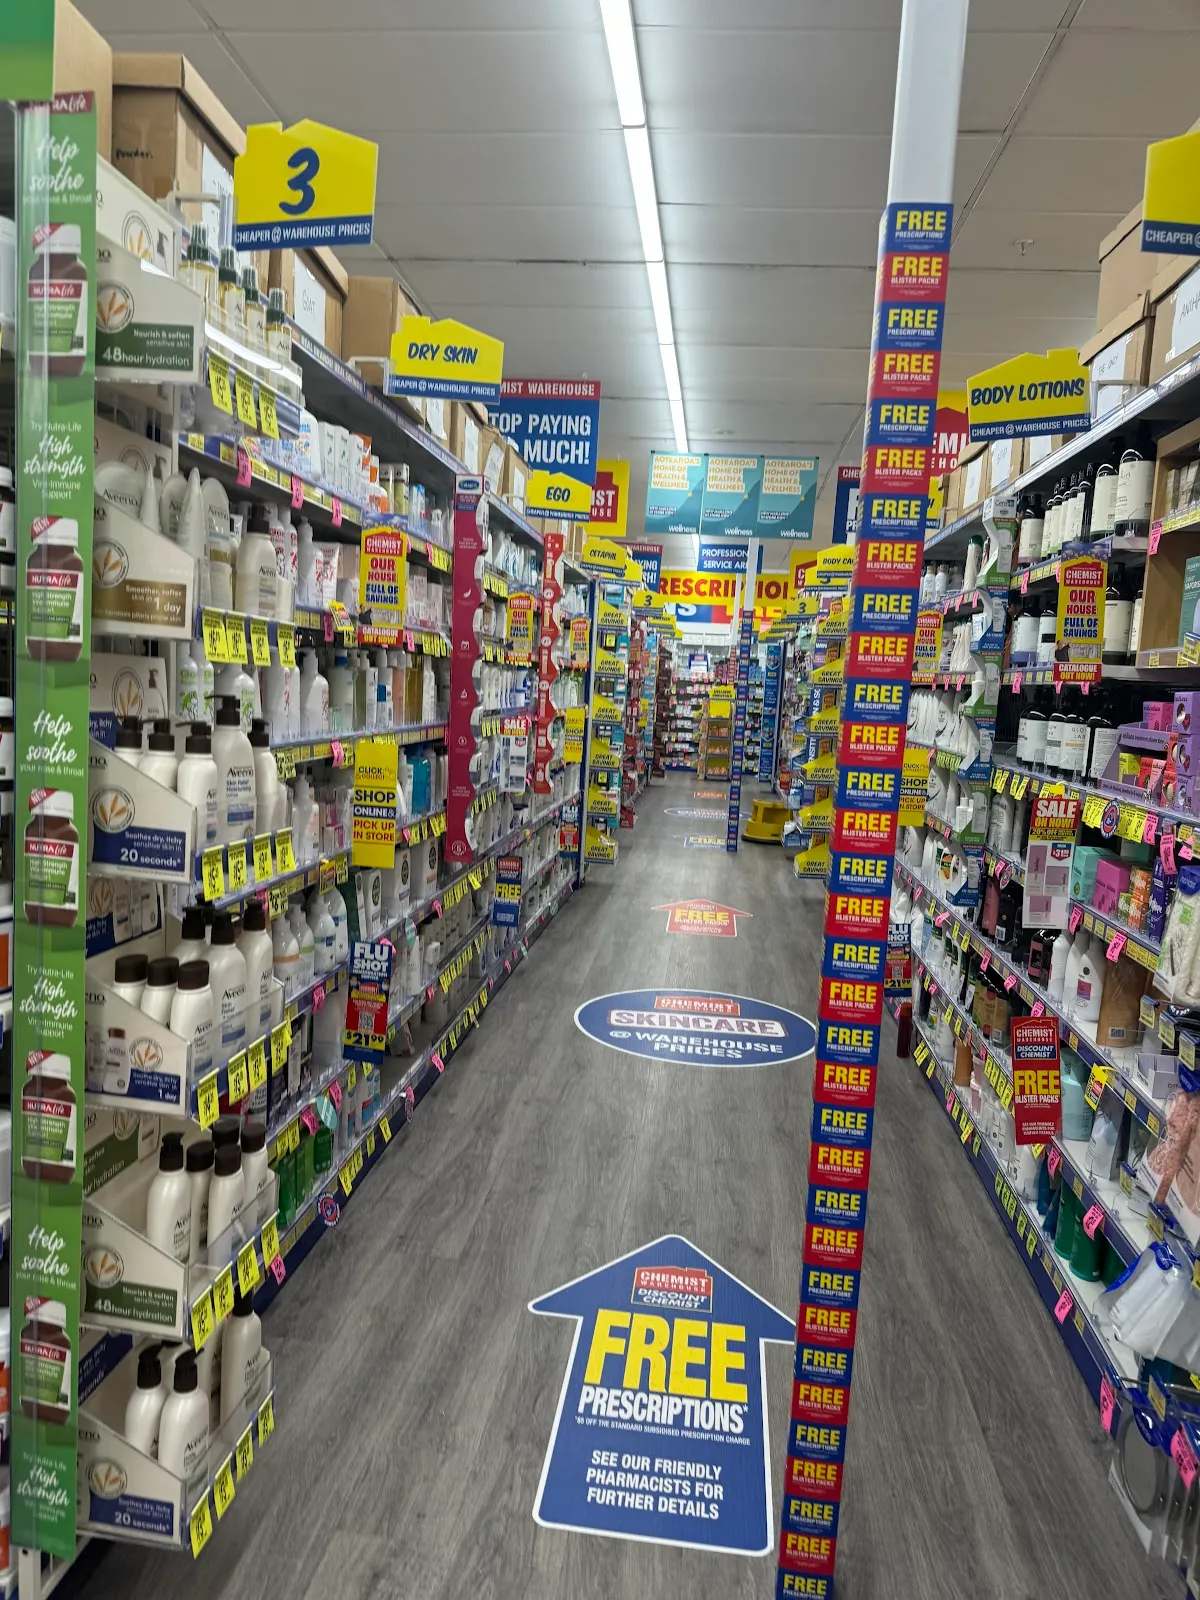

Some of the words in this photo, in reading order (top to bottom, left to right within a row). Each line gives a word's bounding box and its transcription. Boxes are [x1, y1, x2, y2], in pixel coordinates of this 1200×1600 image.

[36, 135, 80, 163] Help
[29, 163, 85, 193] soothe
[279, 147, 321, 216] 3
[896, 210, 947, 231] FREE
[235, 229, 271, 243] CHEAPER
[271, 226, 282, 243] @
[282, 225, 336, 240] WAREHOUSE
[338, 222, 370, 236] PRICES
[1145, 229, 1194, 245] CHEAPER
[891, 256, 943, 277] FREE
[888, 309, 938, 329] FREE
[168, 332, 190, 340] soften
[145, 353, 190, 367] hydration
[408, 342, 440, 360] DRY
[443, 345, 478, 364] SKIN
[884, 353, 934, 374] FREE
[428, 383, 469, 394] WAREHOUSE
[471, 385, 496, 396] PRICES
[528, 382, 595, 396] WAREHOUSE
[971, 385, 1014, 406] BODY
[1018, 377, 1085, 401] LOTIONS
[880, 405, 930, 424] FREE
[489, 412, 522, 433] TOP
[528, 413, 592, 437] PAYING
[972, 426, 1005, 437] CHEAPER
[1005, 424, 1015, 435] @
[1015, 420, 1061, 431] WAREHOUSE
[1062, 418, 1089, 428] PRICES
[38, 432, 74, 459] High
[524, 439, 591, 465] MUCH!
[23, 451, 86, 479] strength
[876, 448, 926, 469] FREE
[546, 486, 571, 502] EGO
[871, 499, 921, 519] FREE
[668, 525, 697, 534] wellness
[725, 528, 753, 536] wellness
[780, 530, 809, 538] wellness
[366, 538, 402, 550] CHEMIST
[867, 542, 917, 563] FREE
[702, 549, 749, 557] PROFESSION
[371, 558, 396, 570] OUR
[703, 560, 733, 569] SERVICE
[735, 561, 748, 569] AR
[368, 571, 396, 582] HOUSE
[1066, 569, 1102, 580] CHEMIST
[366, 584, 385, 594] FULL
[388, 585, 399, 594] OF
[1069, 590, 1096, 603] OUR
[366, 594, 398, 604] SAVINGS
[644, 595, 653, 607] 3
[799, 602, 806, 613] 3
[863, 593, 913, 613] FREE
[163, 603, 181, 614] day
[1066, 604, 1097, 615] HOUSE
[1064, 617, 1084, 628] FULL
[1087, 618, 1098, 628] OF
[362, 627, 398, 636] CATALOGUE
[364, 635, 378, 643] OUT
[379, 635, 397, 644] NOW!
[919, 629, 936, 637] OUR
[1063, 628, 1098, 638] SAVINGS
[858, 635, 908, 656] FREE
[1059, 664, 1097, 673] CATALOGUE
[1061, 671, 1076, 680] OUT
[1077, 671, 1095, 681] NOW!
[854, 683, 903, 704] FREE
[33, 710, 73, 737] Help
[504, 719, 526, 729] SALE
[850, 725, 900, 745] FREE
[26, 742, 78, 764] soothe
[63, 766, 85, 777] throat
[847, 771, 895, 791] FREE
[901, 778, 928, 787] SHOP
[354, 789, 396, 803] SHOP
[354, 806, 388, 817] ONLINE
[1036, 800, 1077, 818] SALE
[354, 820, 378, 830] PICK
[381, 821, 394, 831] UP
[843, 811, 891, 832] FREE
[1035, 818, 1047, 827] ON
[1049, 817, 1074, 829] NOW!
[165, 836, 182, 845] itchy
[354, 830, 363, 839] IN
[366, 832, 394, 841] STORE
[120, 848, 139, 862] 20
[496, 884, 521, 898] FREE
[675, 908, 729, 922] FREE
[354, 942, 389, 960] FLU
[833, 943, 880, 963] FREE
[353, 958, 389, 972] SHOT
[34, 976, 66, 999] High
[19, 998, 79, 1020] strength
[614, 1011, 781, 1035] SKINCARE
[1016, 1028, 1053, 1038] CHEMIST
[635, 1031, 784, 1054] WAREHOUSE
[654, 1042, 743, 1059] PRICES
[1014, 1070, 1060, 1095] FREE
[1015, 1094, 1038, 1104] BLISTER
[1039, 1095, 1058, 1103] PACKS
[821, 1108, 867, 1129] FREE
[28, 1225, 67, 1256] Help
[21, 1252, 70, 1277] soothe
[640, 1271, 709, 1288] CHEMIST
[638, 1288, 707, 1303] DISCOUNT
[643, 1296, 701, 1309] CHEMIST
[806, 1307, 851, 1328] FREE
[584, 1308, 748, 1403] FREE
[586, 1418, 597, 1426] OFF
[598, 1419, 610, 1427] THE
[611, 1420, 643, 1432] STANDARD
[644, 1425, 680, 1436] SUBSIDISED
[681, 1429, 725, 1442] PRESCRIPTION
[725, 1436, 751, 1446] CHARGE
[591, 1449, 618, 1467] SEE
[622, 1453, 651, 1472] OUR
[654, 1457, 722, 1481] FRIENDLY
[29, 1465, 60, 1487] High
[586, 1467, 691, 1496] PHARMACISTS
[695, 1481, 724, 1500] FOR
[17, 1478, 70, 1507] strength
[587, 1487, 654, 1511] FURTHER
[658, 1499, 719, 1520] DETAILS
[790, 1499, 833, 1520] FREE
[115, 1511, 132, 1524] 20
